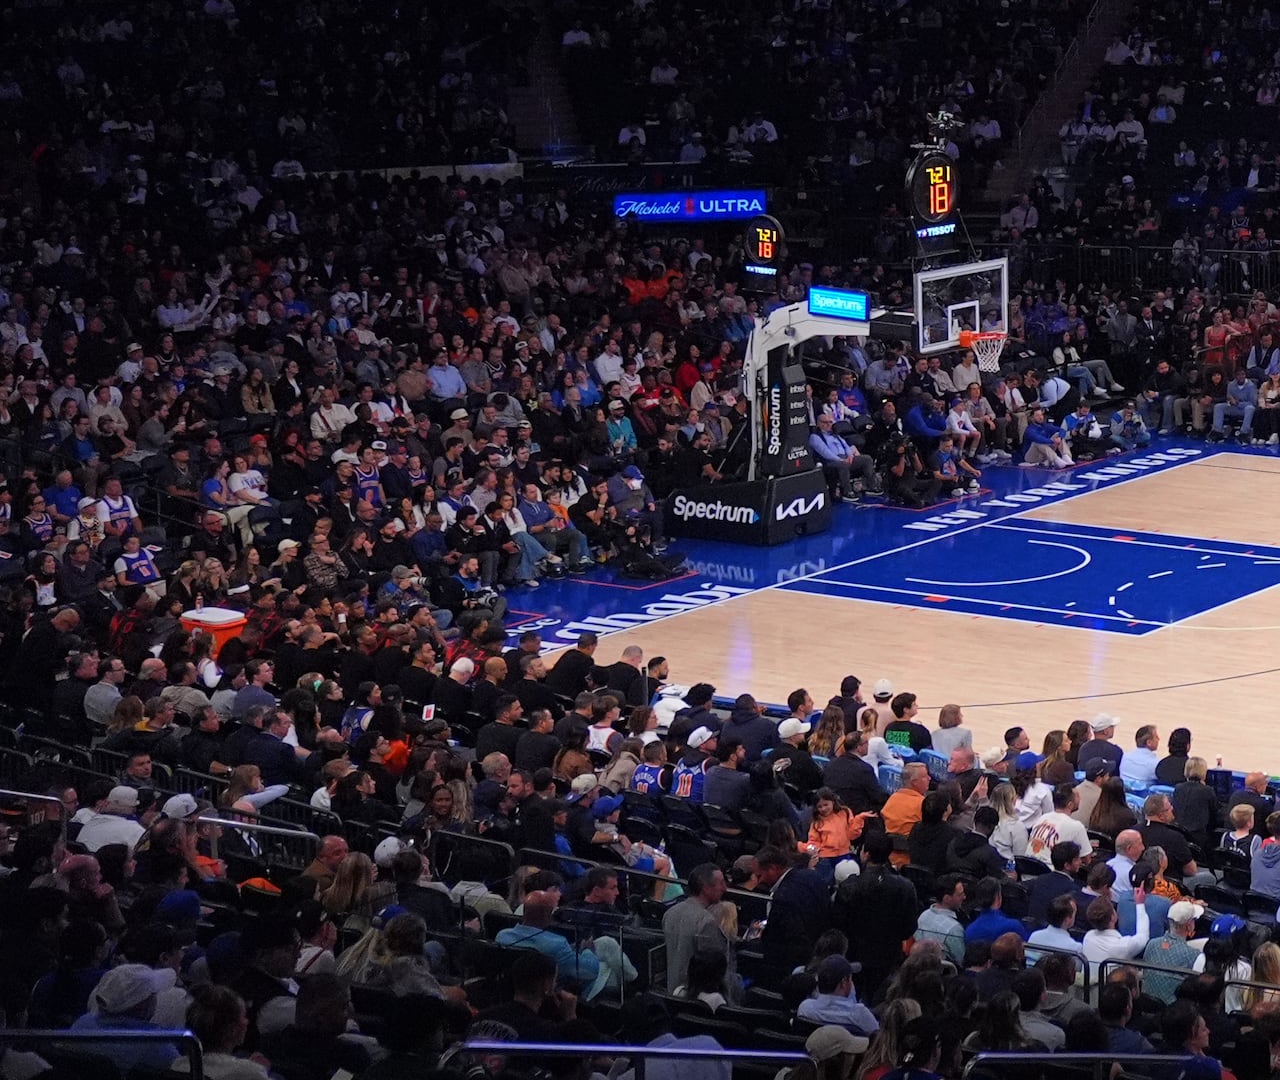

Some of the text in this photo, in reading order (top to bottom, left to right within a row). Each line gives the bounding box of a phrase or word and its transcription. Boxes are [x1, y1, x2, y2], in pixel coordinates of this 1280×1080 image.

[926, 166, 951, 184] 7:21
[930, 183, 949, 214] 18
[615, 199, 762, 217] Michelob ULTRA
[756, 228, 777, 243] 7:21
[928, 224, 955, 237] TISSOT
[759, 242, 772, 259] 18
[814, 294, 861, 310] Spectrum
[768, 388, 781, 455] Spectrum
[787, 449, 808, 461] ULTRA
[902, 447, 1202, 532] NEW YORK KNICKS
[673, 495, 754, 524] Spectrum
[556, 583, 756, 640] dhabi
[929, 755, 947, 768] TEN
[676, 774, 693, 797] 11
